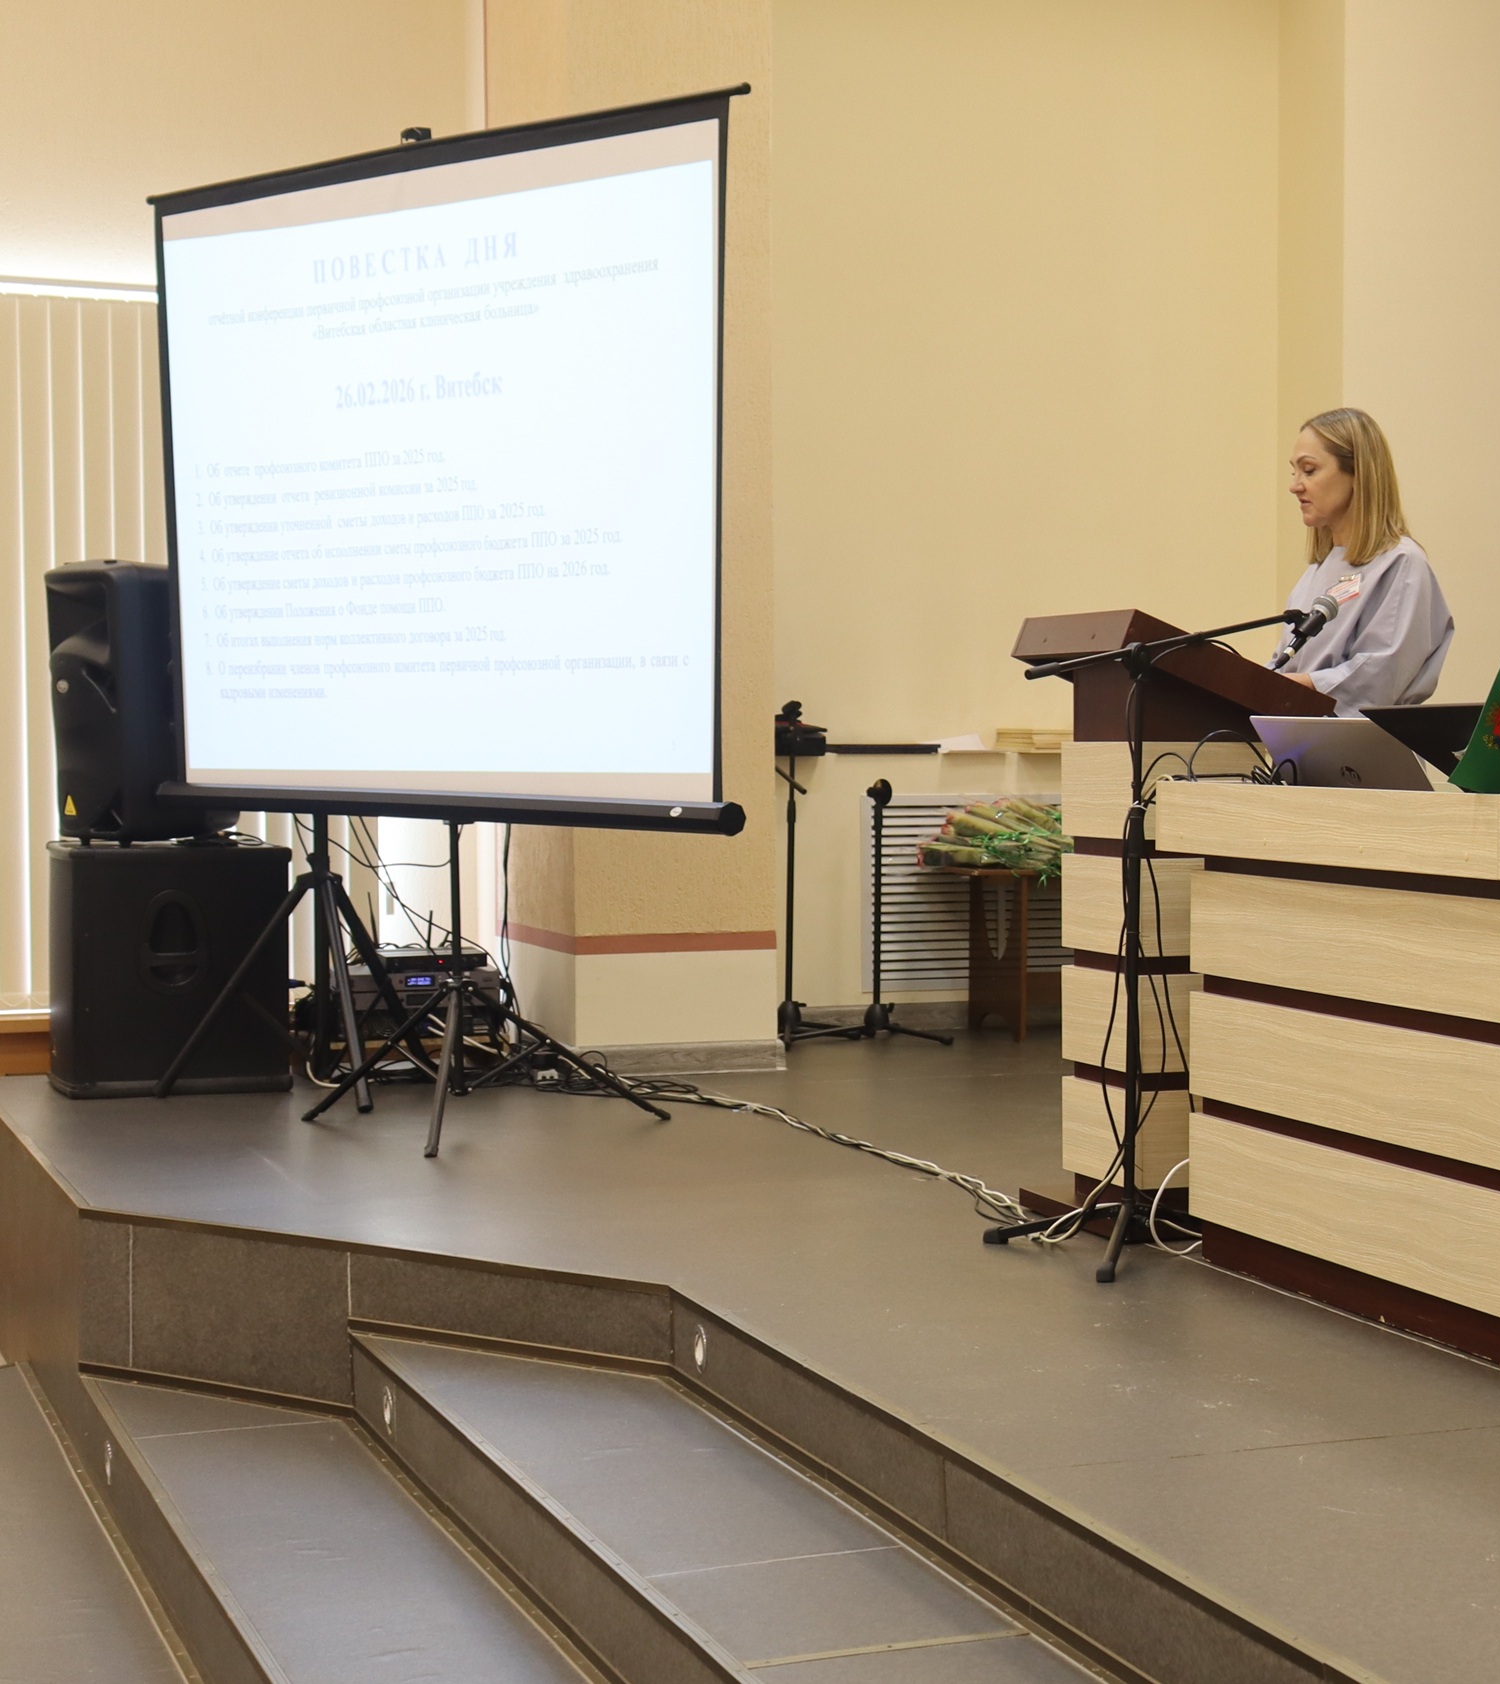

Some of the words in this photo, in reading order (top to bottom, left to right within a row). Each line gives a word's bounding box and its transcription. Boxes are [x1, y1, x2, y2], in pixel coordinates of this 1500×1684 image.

[312, 243, 446, 284] ПОВЕСТКА
[464, 232, 518, 269] ДНЯ
[248, 306, 304, 325] конференции
[306, 297, 356, 320] первичной
[358, 290, 425, 315] профсоюзной
[428, 282, 490, 305] организации
[492, 272, 556, 298] учреждения
[563, 258, 658, 287] здравоохранения
[312, 320, 366, 340] «Витебская
[368, 314, 416, 334] областная
[420, 309, 480, 328] клиническая
[484, 302, 539, 321] больница»
[335, 377, 414, 409] 26.02.2026
[420, 384, 430, 401] г.
[434, 371, 502, 400] Витебск
[207, 463, 220, 478] Об
[254, 460, 316, 480] профсоюзного
[319, 457, 362, 472] комитета
[364, 451, 389, 466] ППО
[392, 455, 400, 466] за
[404, 448, 424, 465] 2025
[208, 492, 221, 506] Об
[281, 492, 310, 503] отчета
[314, 483, 376, 506] ревизионной
[379, 482, 421, 496] комиссии
[424, 482, 434, 493] за
[436, 476, 458, 492] 2025
[210, 519, 223, 534] Об
[280, 515, 332, 535] уточненной
[337, 515, 367, 528] сметы
[370, 512, 406, 527] доходов
[408, 512, 414, 524] и
[417, 508, 460, 528] расходов
[462, 504, 484, 520] ППО
[487, 508, 496, 519] за
[500, 502, 524, 519] 2025
[528, 504, 546, 517] год.
[212, 548, 224, 562] Об
[281, 548, 310, 560] отчета
[312, 544, 322, 558] об
[324, 544, 382, 559] исполнении
[384, 543, 411, 554] сметы
[414, 538, 482, 557] профсоюзного
[484, 534, 528, 550] бюджета
[531, 531, 556, 547] ППО
[560, 533, 570, 545] за
[574, 528, 599, 544] 2025
[602, 528, 623, 544] год.
[214, 577, 226, 591] Об
[283, 578, 310, 590] сметы
[312, 576, 348, 589] доходов
[352, 575, 357, 586] и
[360, 574, 400, 590] расходов
[403, 568, 472, 588] профсоюзного
[474, 566, 514, 582] бюджета
[518, 563, 544, 579] ППО
[547, 566, 558, 578] на
[562, 561, 586, 577] 2026
[590, 561, 610, 576] год.
[215, 604, 228, 618] Об
[286, 603, 336, 618] Положения
[338, 605, 344, 614] о
[346, 601, 377, 616] Фонде
[380, 602, 416, 615] помощи
[418, 597, 446, 613] ППО.
[216, 633, 229, 647] Об
[231, 635, 259, 646] итогах
[261, 635, 312, 646] выполнения
[314, 634, 336, 650] норм
[340, 632, 406, 646] коллективного
[408, 630, 450, 646] договора
[454, 630, 462, 642] за
[466, 626, 487, 642] 2025
[218, 661, 225, 674] О
[290, 662, 320, 674] членов
[324, 659, 390, 678] профсоюзного
[394, 660, 435, 672] комитета
[440, 656, 490, 676] первичной
[494, 654, 560, 675] профсоюзной
[565, 654, 635, 674] организации,
[640, 654, 646, 667] в
[650, 654, 678, 667] связи
[683, 654, 689, 666] с
[220, 688, 266, 703] кадровыми
